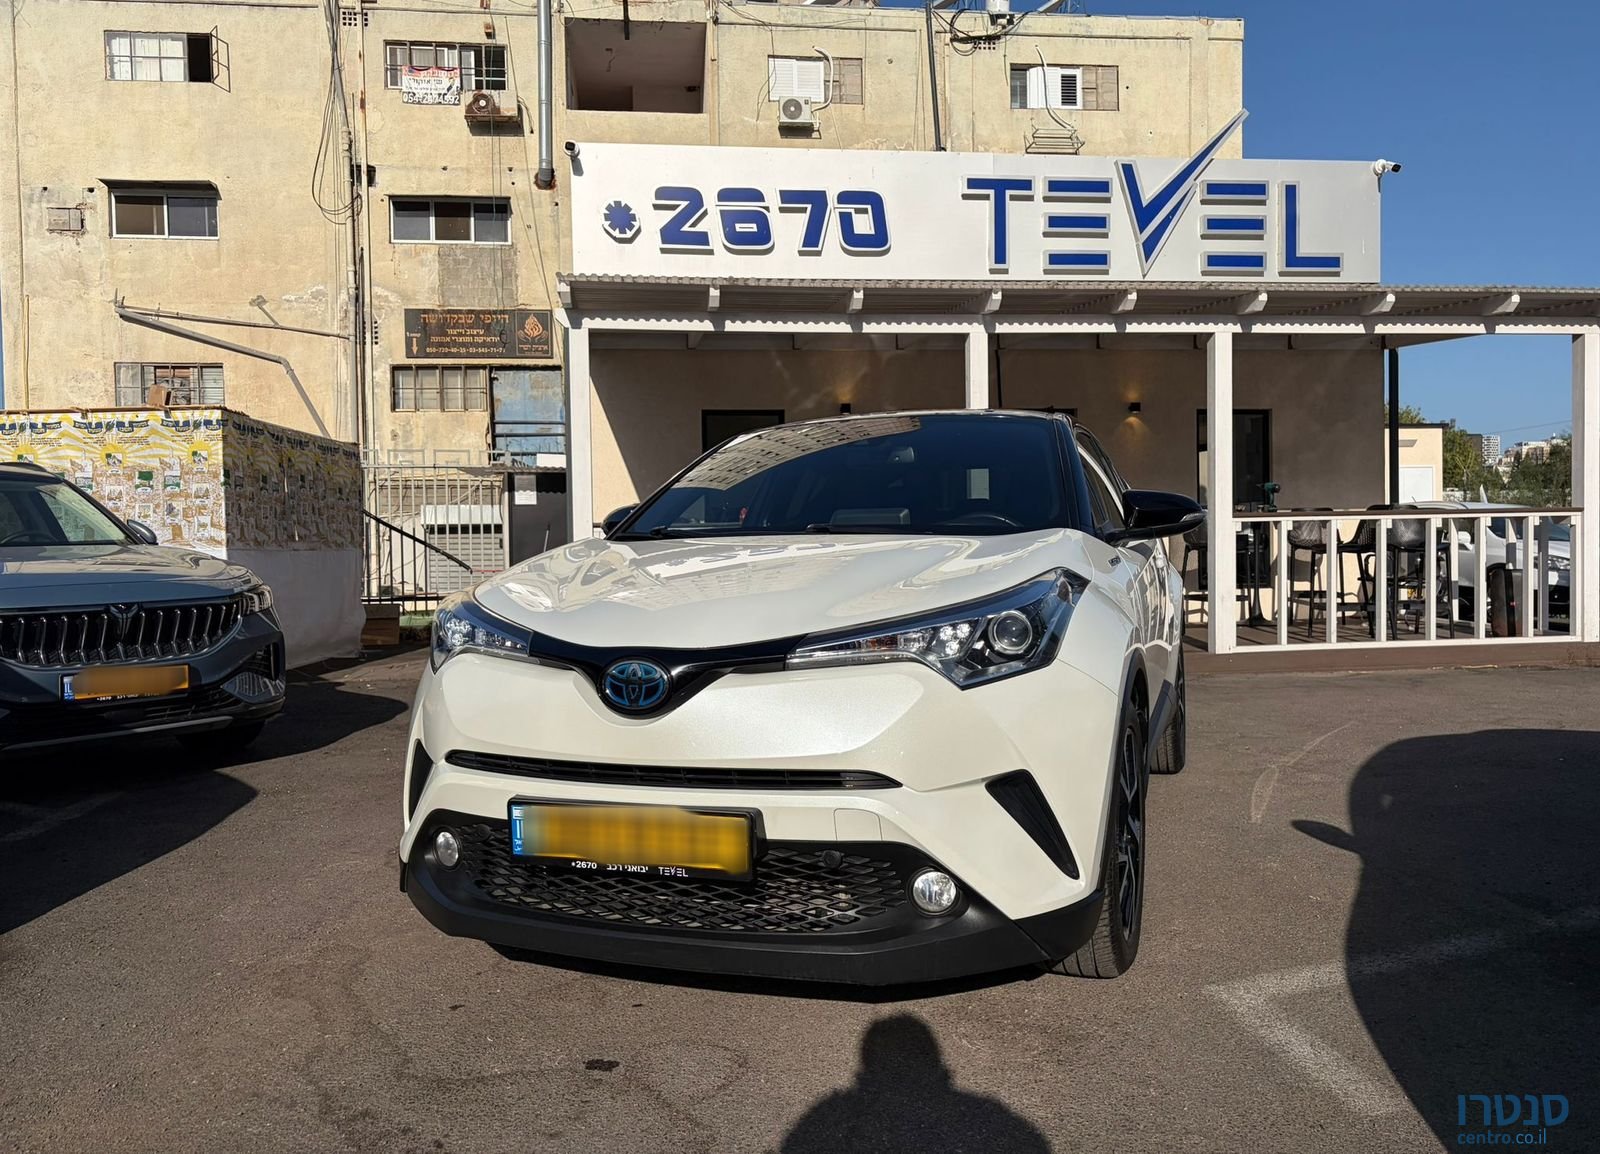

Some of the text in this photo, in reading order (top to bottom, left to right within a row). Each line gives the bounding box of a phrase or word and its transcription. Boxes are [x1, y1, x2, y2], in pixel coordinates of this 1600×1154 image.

[962, 109, 1343, 278] TEVEL
[606, 863, 649, 873] יבואני רכב
[657, 866, 689, 878] TEVEL
